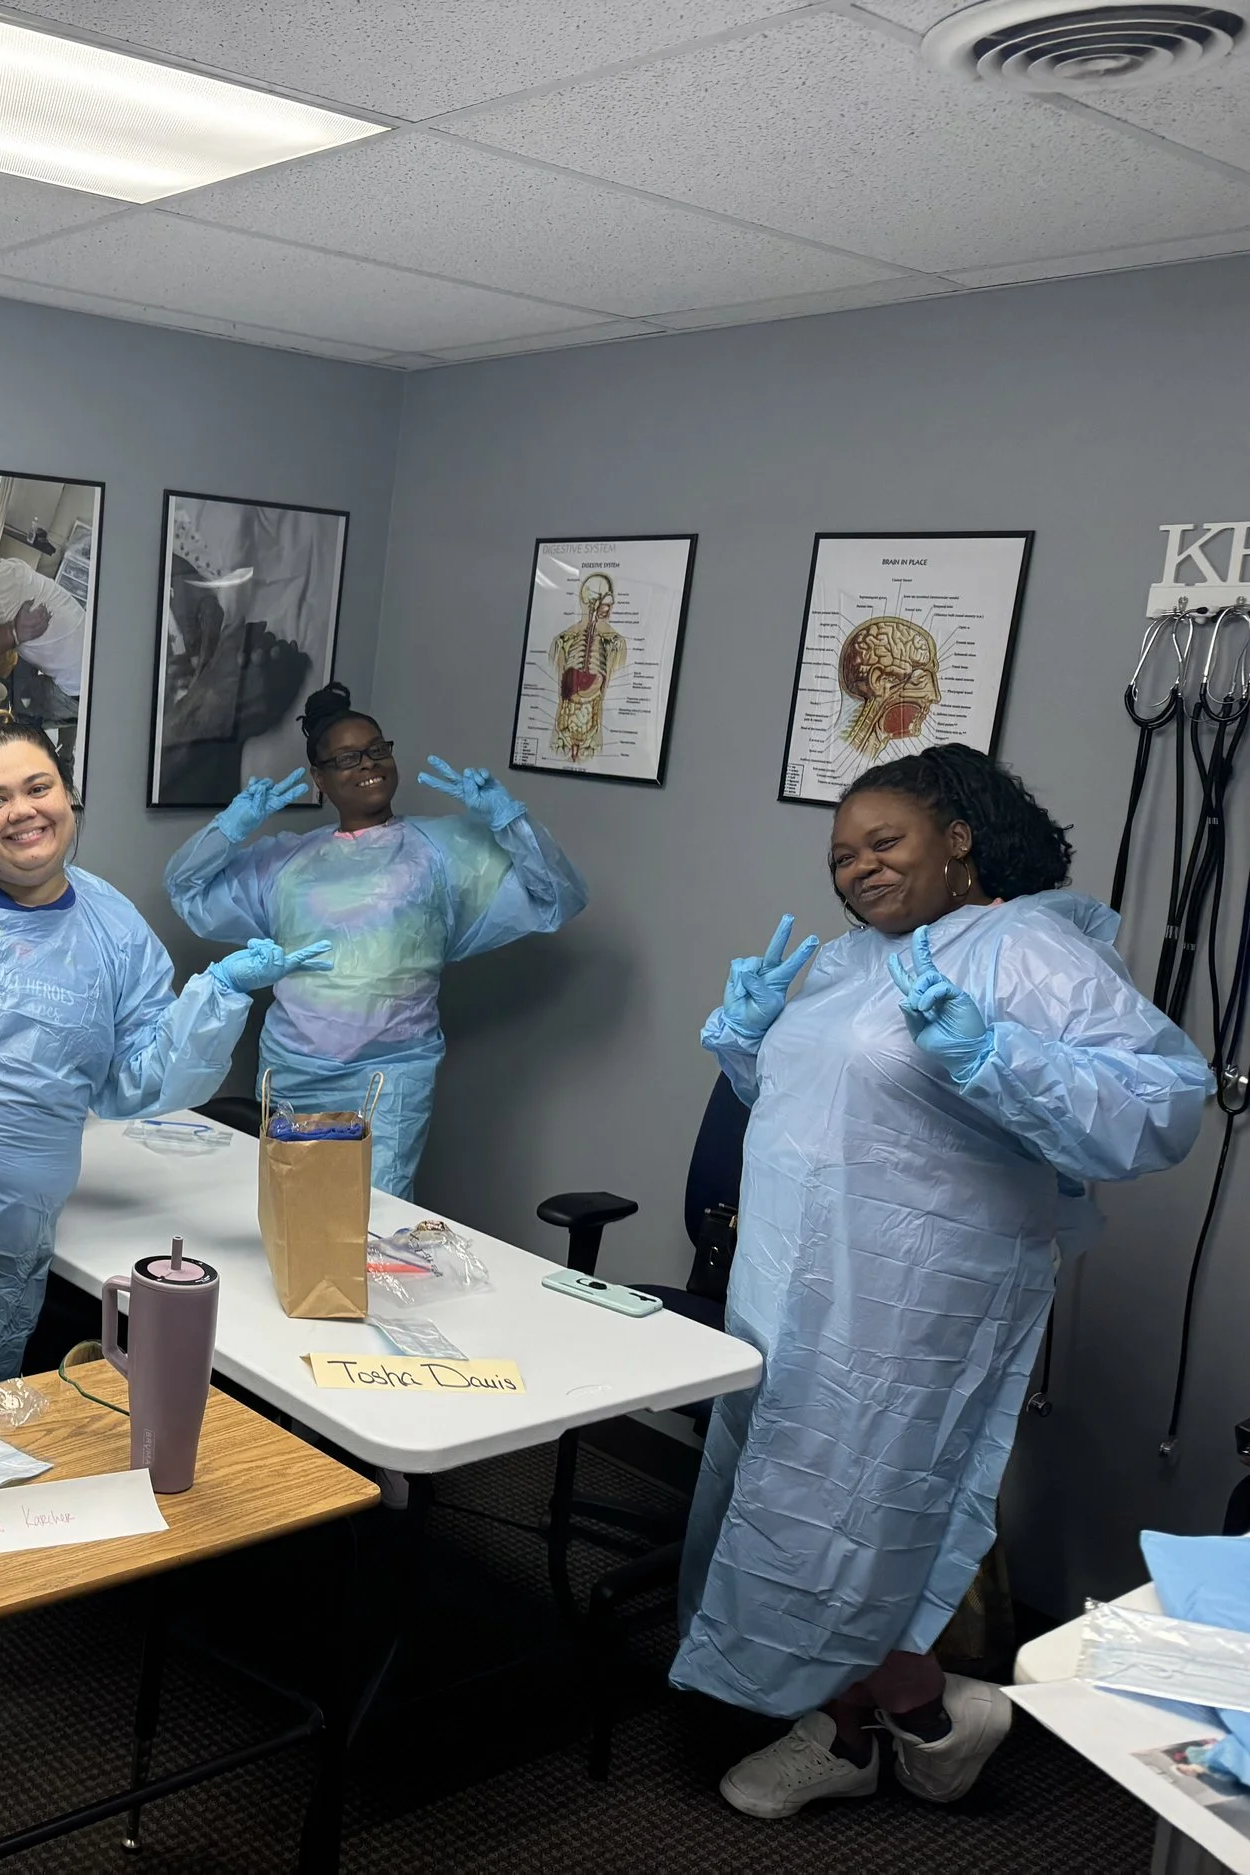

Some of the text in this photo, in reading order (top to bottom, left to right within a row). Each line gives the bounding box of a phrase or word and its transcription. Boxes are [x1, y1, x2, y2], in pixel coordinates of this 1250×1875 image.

[542, 543, 617, 555] DIGESTIVE SYSTEM
[881, 558, 928, 566] BRAIN IN PLACE
[26, 978, 75, 1006] HEROES
[326, 1360, 518, 1390] Tosha Davis
